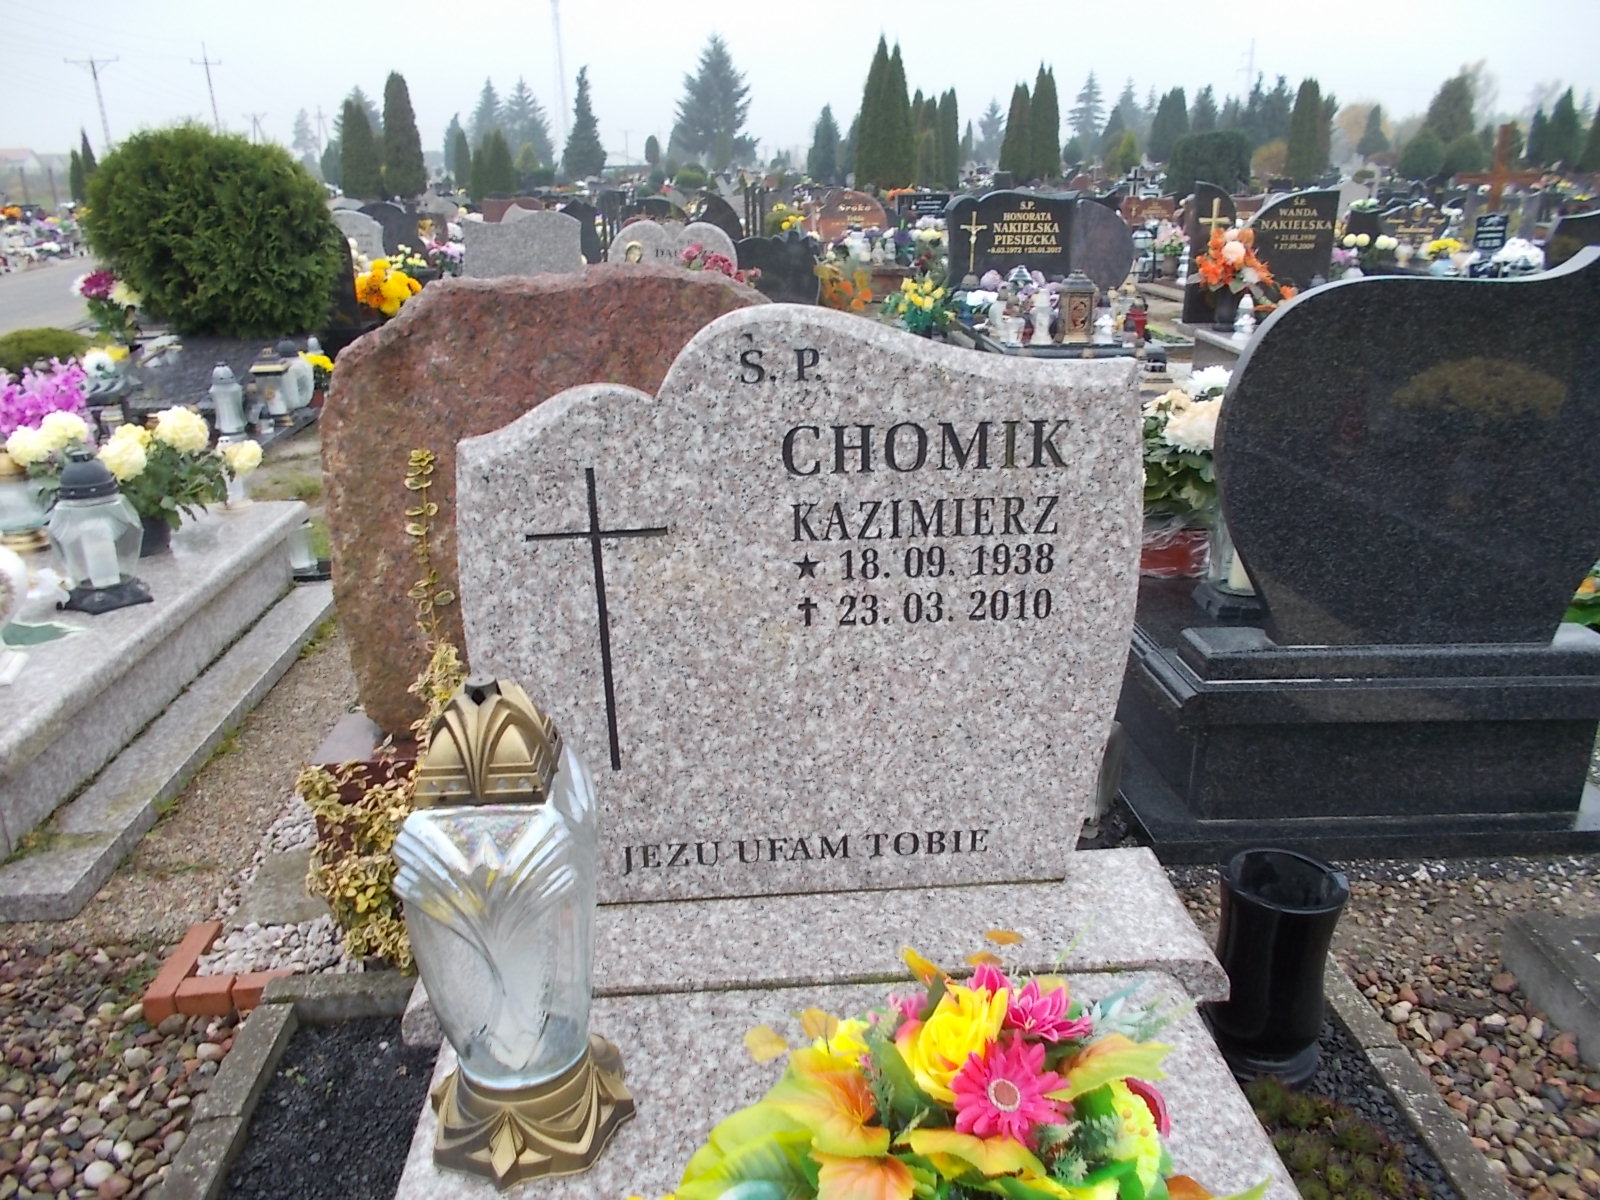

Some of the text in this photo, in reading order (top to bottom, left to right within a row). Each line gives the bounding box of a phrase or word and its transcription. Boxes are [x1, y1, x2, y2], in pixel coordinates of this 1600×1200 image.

[993, 222, 1060, 233] NAKIELSKA
[1003, 212, 1052, 221] HONORATA
[1260, 220, 1332, 230] NAKIELSKA
[1279, 208, 1318, 217] WANDA
[994, 235, 1057, 245] PIESIECKA
[794, 348, 823, 382] P.
[782, 419, 1069, 476] CHOMIK
[791, 496, 1060, 542] KAZIMIERZ
[840, 543, 1055, 580] 18. 09. 1938
[839, 588, 1053, 627] 23. 03. 2010
[622, 829, 990, 875] JEZU UFAM TOBIE
